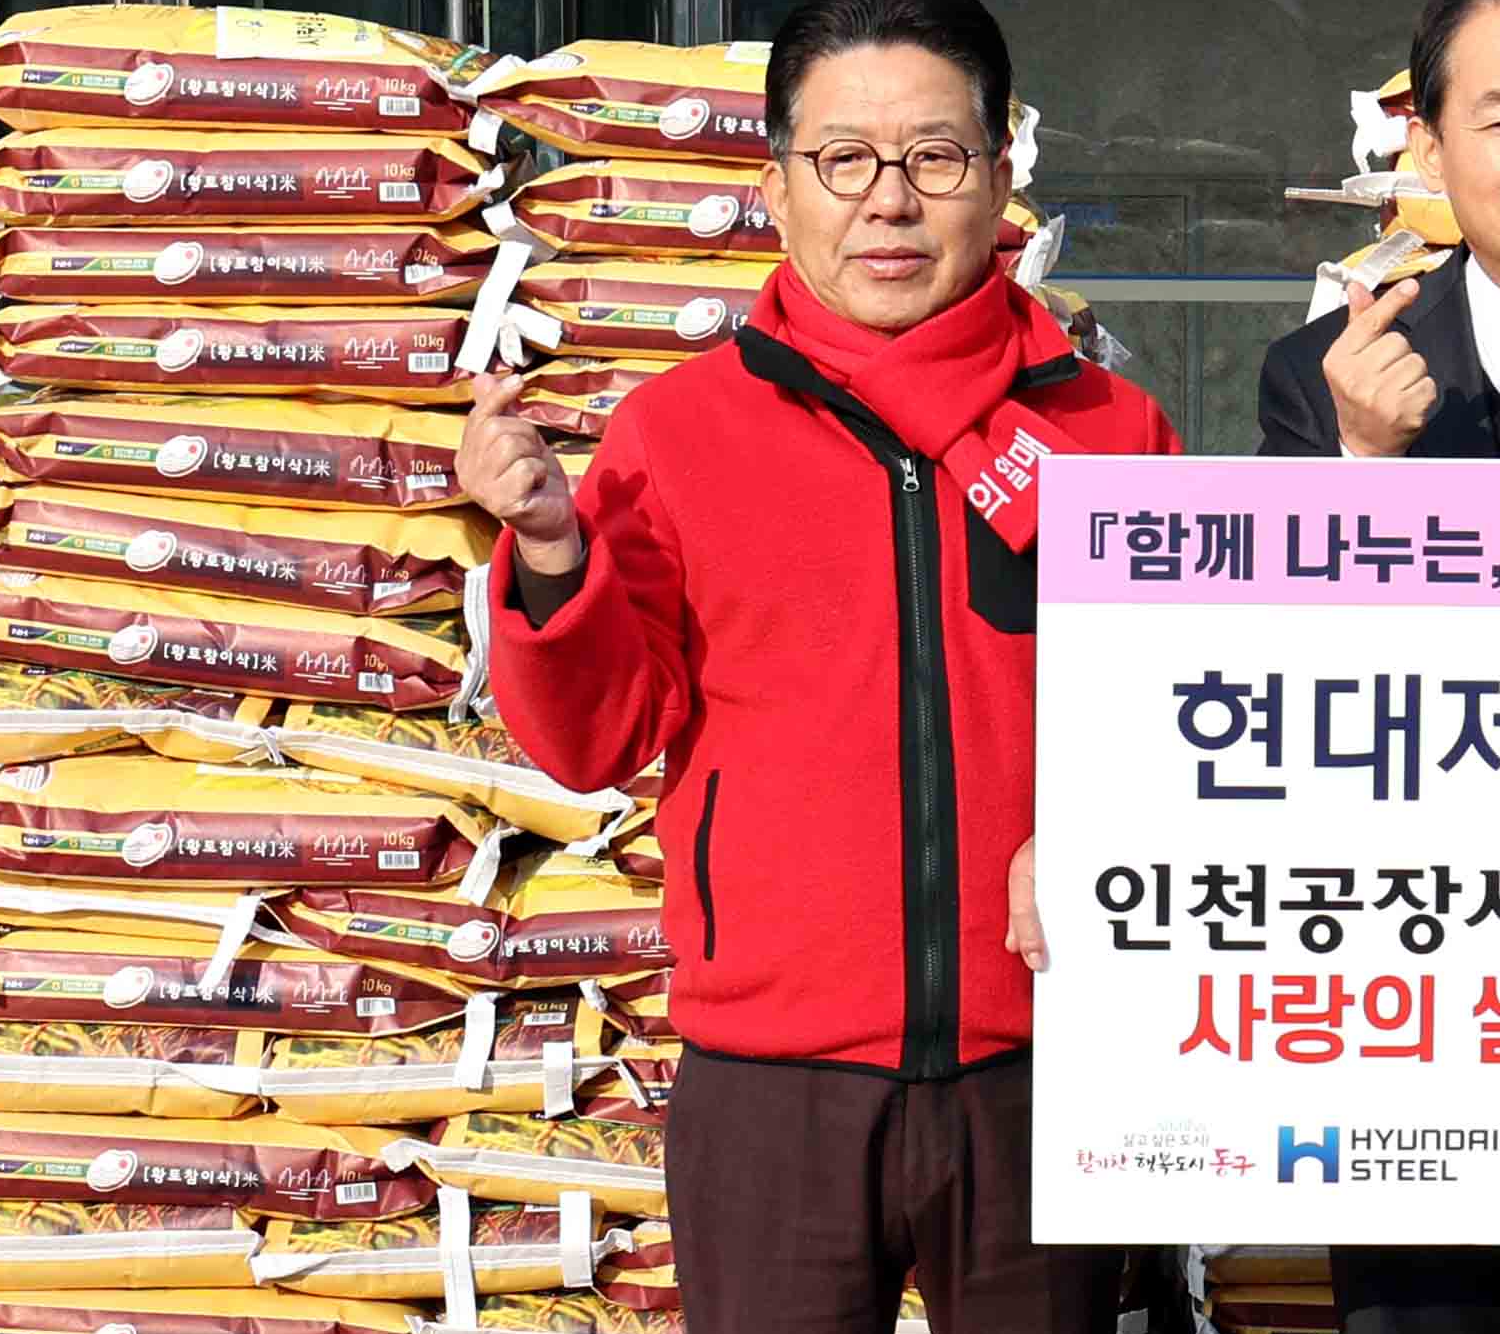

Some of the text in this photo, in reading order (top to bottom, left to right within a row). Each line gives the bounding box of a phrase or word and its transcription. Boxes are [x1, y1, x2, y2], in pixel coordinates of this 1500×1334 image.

[411, 248, 438, 265] 0kg
[1180, 974, 1435, 1064] 사랑의
[1351, 1129, 1498, 1151] HYUNDAI
[1134, 1151, 1205, 1177] 행복도시
[1208, 1148, 1257, 1177] 동구
[1351, 1160, 1457, 1181] STEEL
